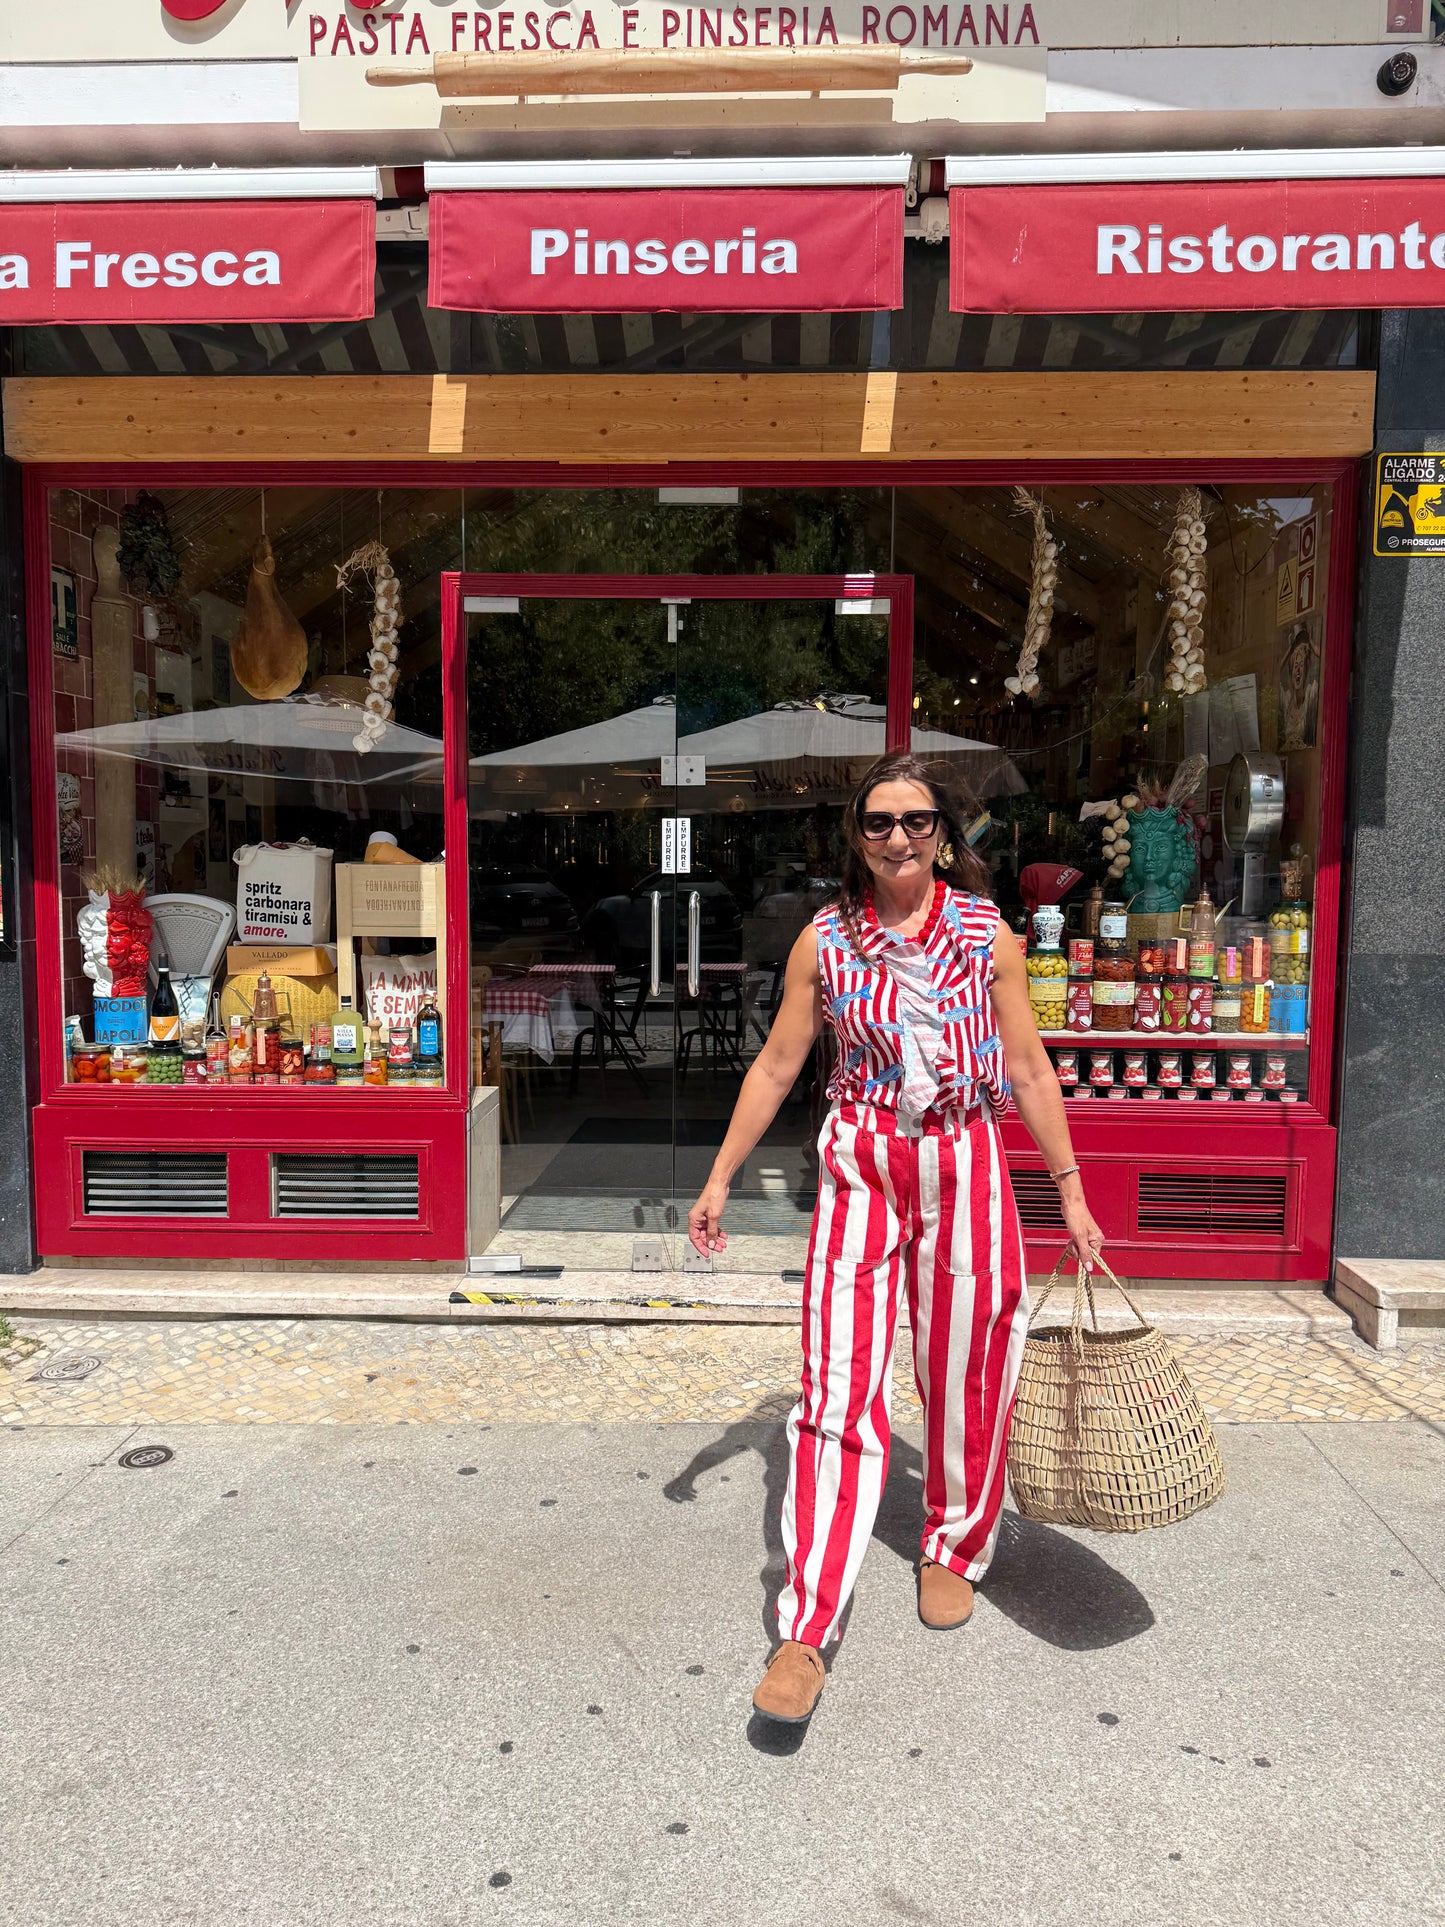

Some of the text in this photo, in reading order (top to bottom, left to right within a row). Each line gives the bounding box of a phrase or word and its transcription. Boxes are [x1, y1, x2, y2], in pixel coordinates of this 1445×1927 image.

[310, 3, 1040, 57] PASTA FRESCA E PINSERIA ROMANA
[529, 227, 798, 277] Pinseria
[56, 241, 281, 289] Fresca
[1385, 458, 1436, 468] ALARME
[1384, 468, 1436, 479] LIGADO
[1438, 474, 1445, 483] 2
[1401, 538, 1445, 546] PROSEGUR
[52, 641, 77, 655] ABACCHI
[245, 881, 282, 896] spritz
[365, 880, 424, 893] FONTANAFREDDA
[245, 895, 311, 911] carbonara
[366, 899, 424, 912] FONTANAFREDDA
[245, 909, 312, 926] tiramisù &
[243, 925, 288, 939] amore.
[252, 951, 288, 959] VALLADO
[370, 971, 386, 991] LA
[384, 991, 438, 1015] SEMPE
[96, 1029, 141, 1042] NAPOLI
